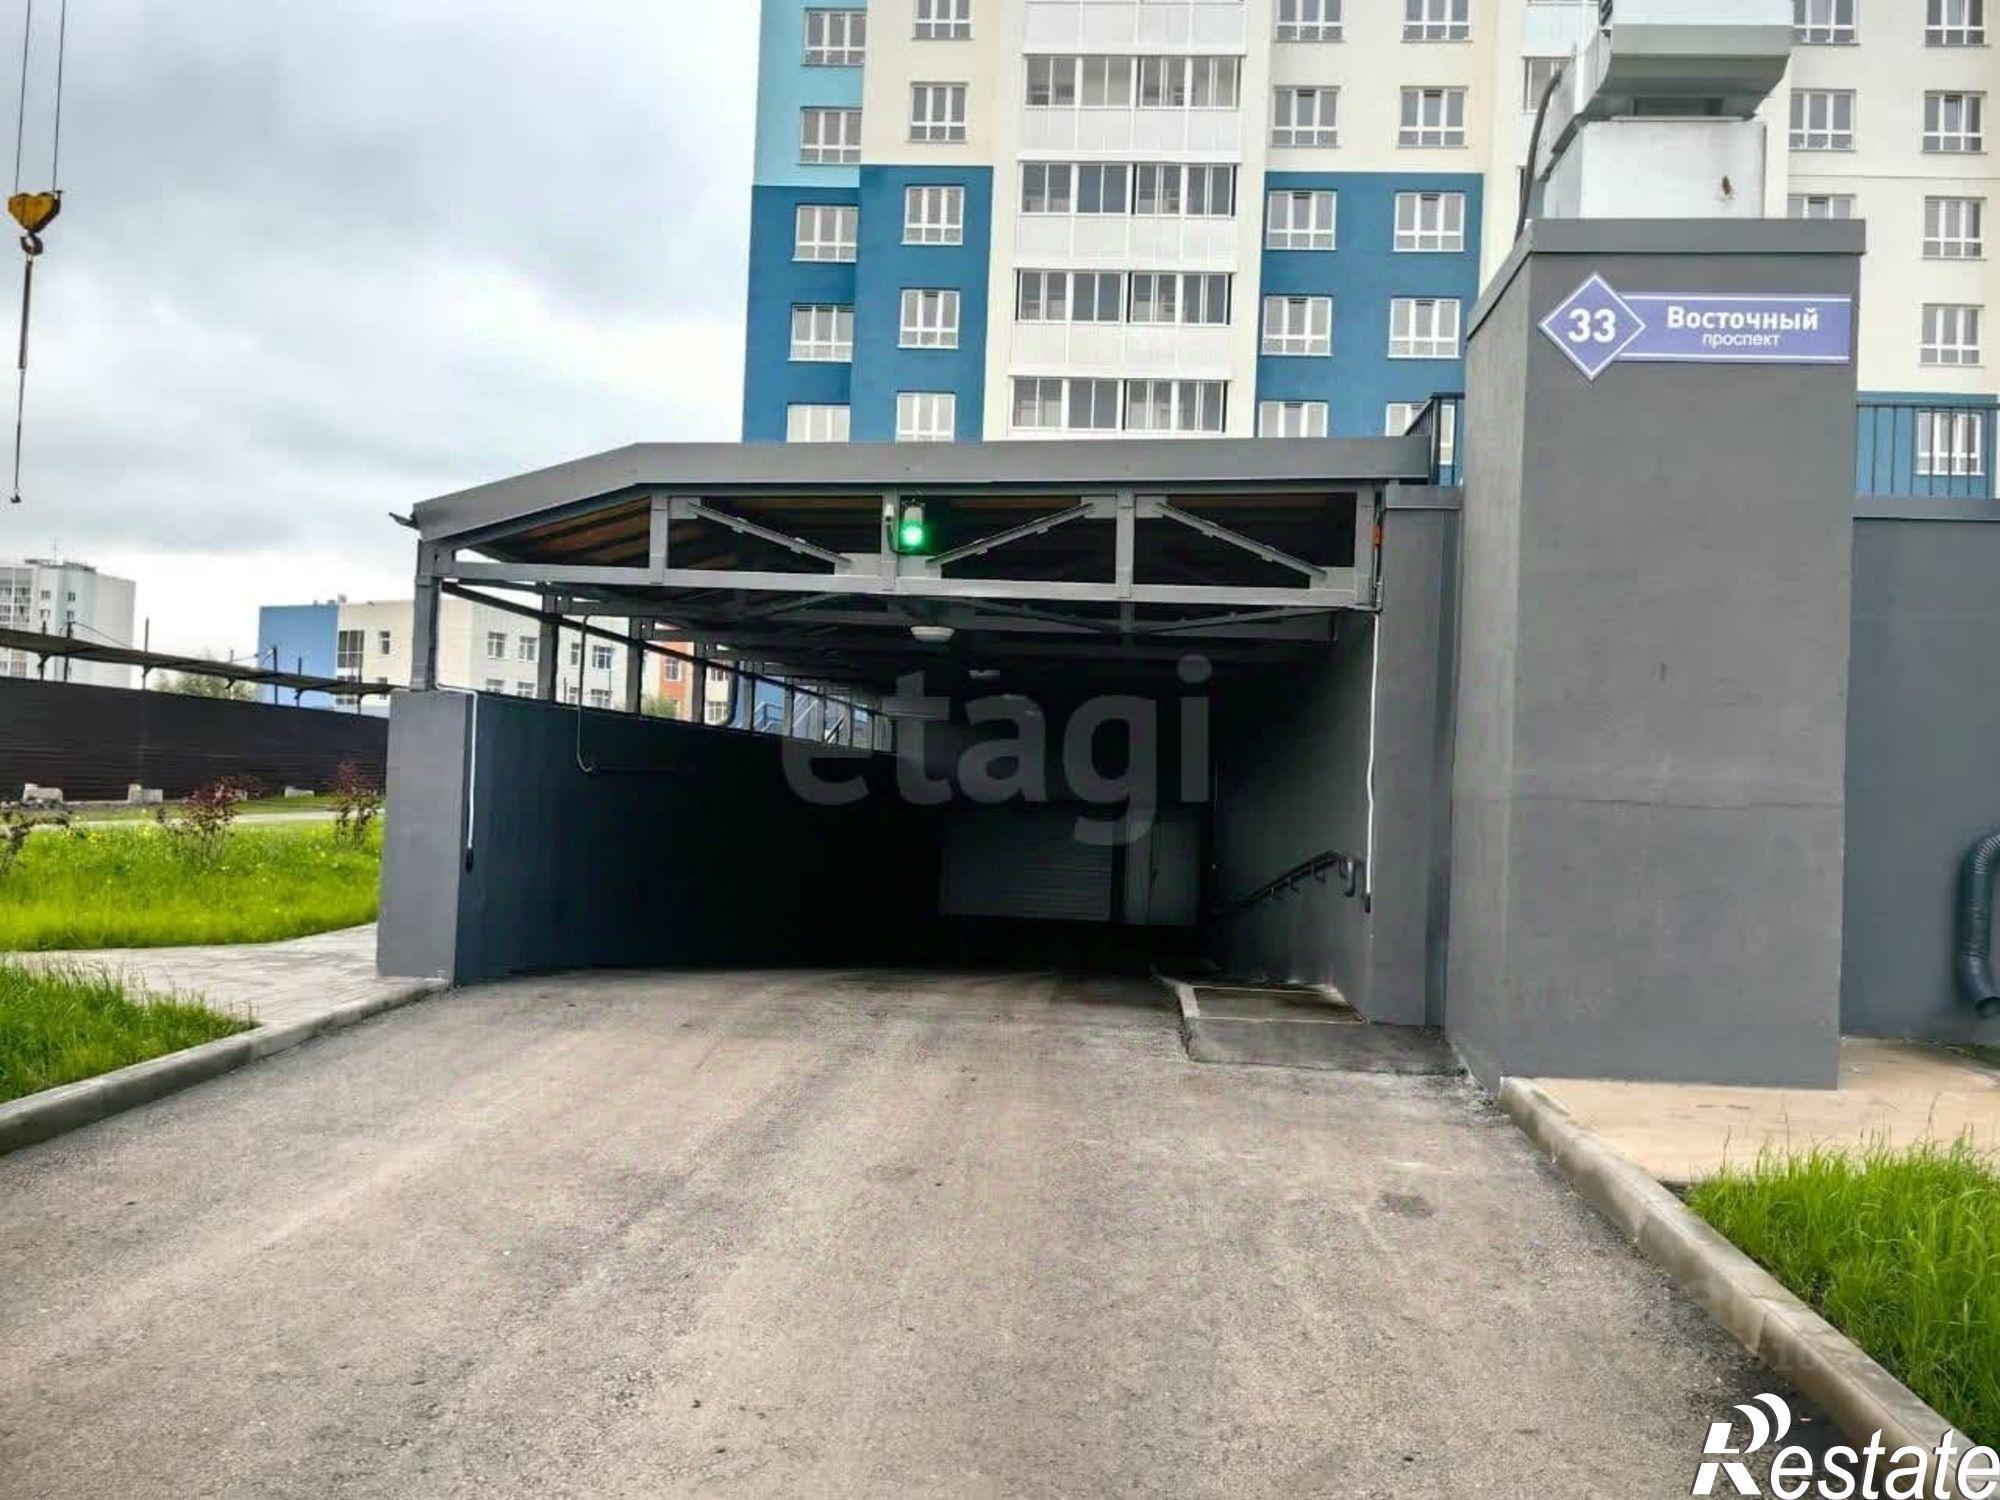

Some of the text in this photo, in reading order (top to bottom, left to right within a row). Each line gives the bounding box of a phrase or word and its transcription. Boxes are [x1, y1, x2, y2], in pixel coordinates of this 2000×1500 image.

[1567, 308, 1617, 344] 33
[1667, 305, 1819, 330] Восточный
[1702, 331, 1781, 348] проспект
